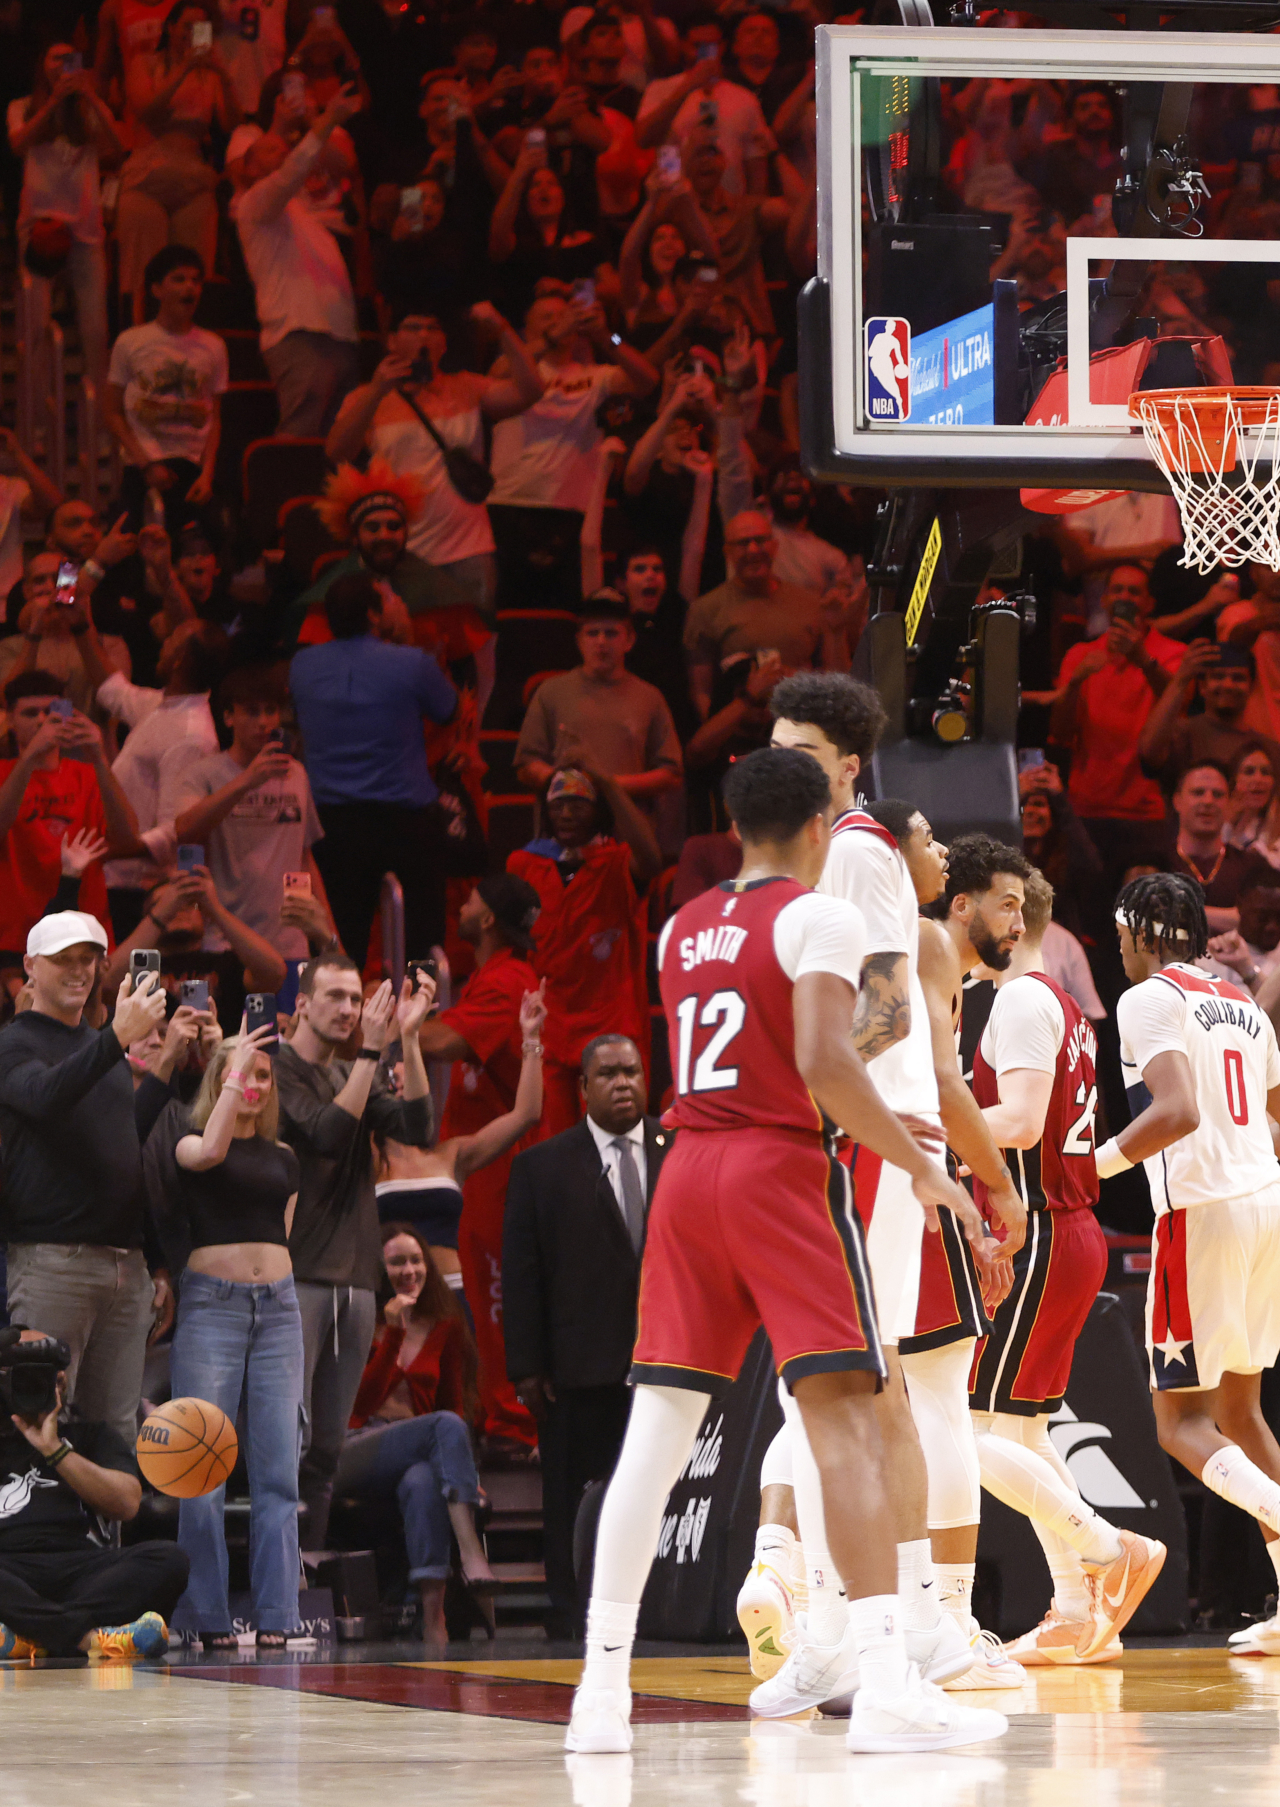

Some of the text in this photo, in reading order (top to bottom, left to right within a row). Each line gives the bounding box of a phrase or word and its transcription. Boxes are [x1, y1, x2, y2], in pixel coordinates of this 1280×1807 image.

[951, 331, 991, 380] ULTRA
[872, 398, 895, 415] NBA
[679, 925, 748, 971] SMITH
[677, 988, 748, 1098] 12
[1194, 1000, 1263, 1060] COULIBALY
[1223, 1048, 1249, 1127] 0
[1061, 1080, 1099, 1157] 2
